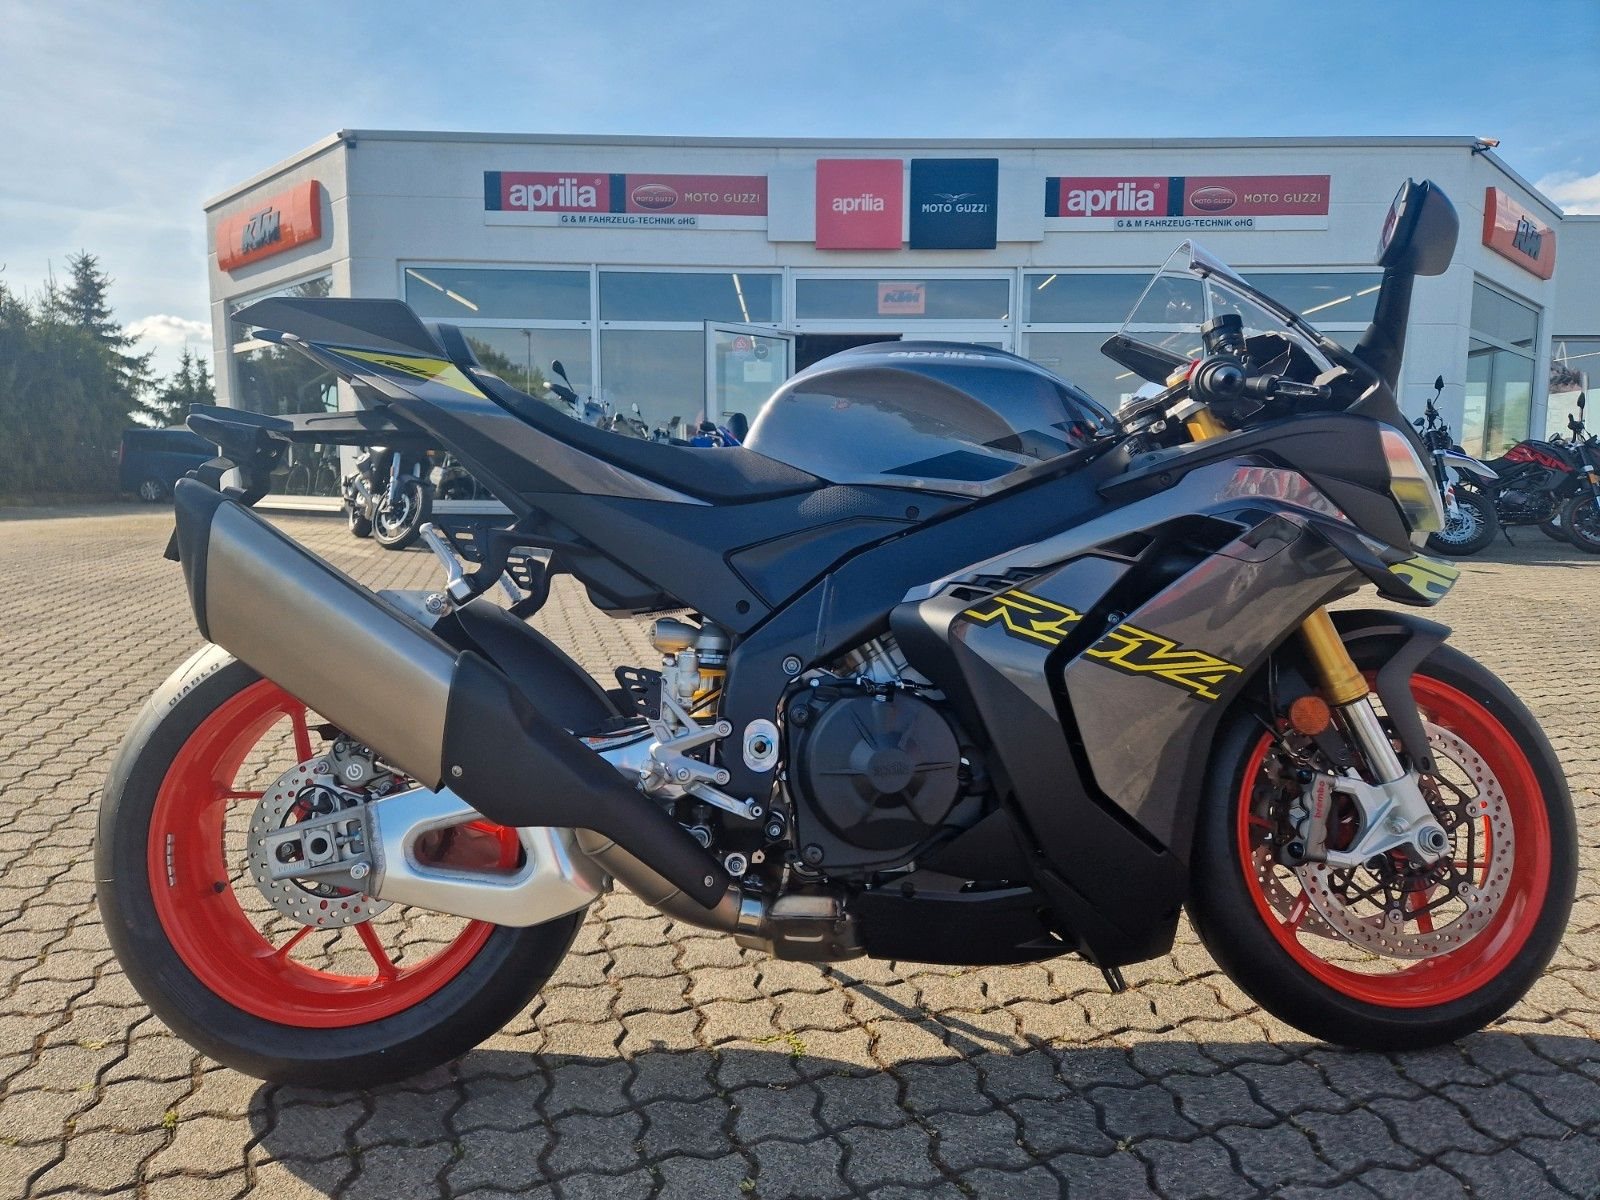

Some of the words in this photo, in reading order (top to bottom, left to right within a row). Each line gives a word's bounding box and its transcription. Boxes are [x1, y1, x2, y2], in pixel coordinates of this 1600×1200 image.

[508, 178, 597, 211] aprilia
[684, 192, 719, 203] MOTO
[723, 193, 760, 203] GUZZI
[1067, 182, 1155, 217] aprilia
[1243, 193, 1280, 203] MOTO
[1283, 193, 1321, 203] GUZZI
[832, 193, 884, 215] aprilia
[921, 203, 952, 213] MOTO
[955, 203, 987, 213] GUZZI
[561, 215, 568, 223] G
[570, 215, 577, 223] &
[578, 215, 587, 223] M
[588, 215, 675, 225] FAHRZEUG-TECHNIK
[677, 217, 696, 225] oHG
[1117, 219, 1124, 228] G
[1126, 219, 1133, 228] &
[1134, 219, 1142, 228] M
[1144, 218, 1232, 228] FAHRZEUG-TECHNIK
[1234, 218, 1253, 227] oHG
[241, 206, 281, 255] KTM
[887, 351, 986, 361] aprilia
[168, 662, 220, 707] DIABLO
[1313, 780, 1326, 819] brembo
